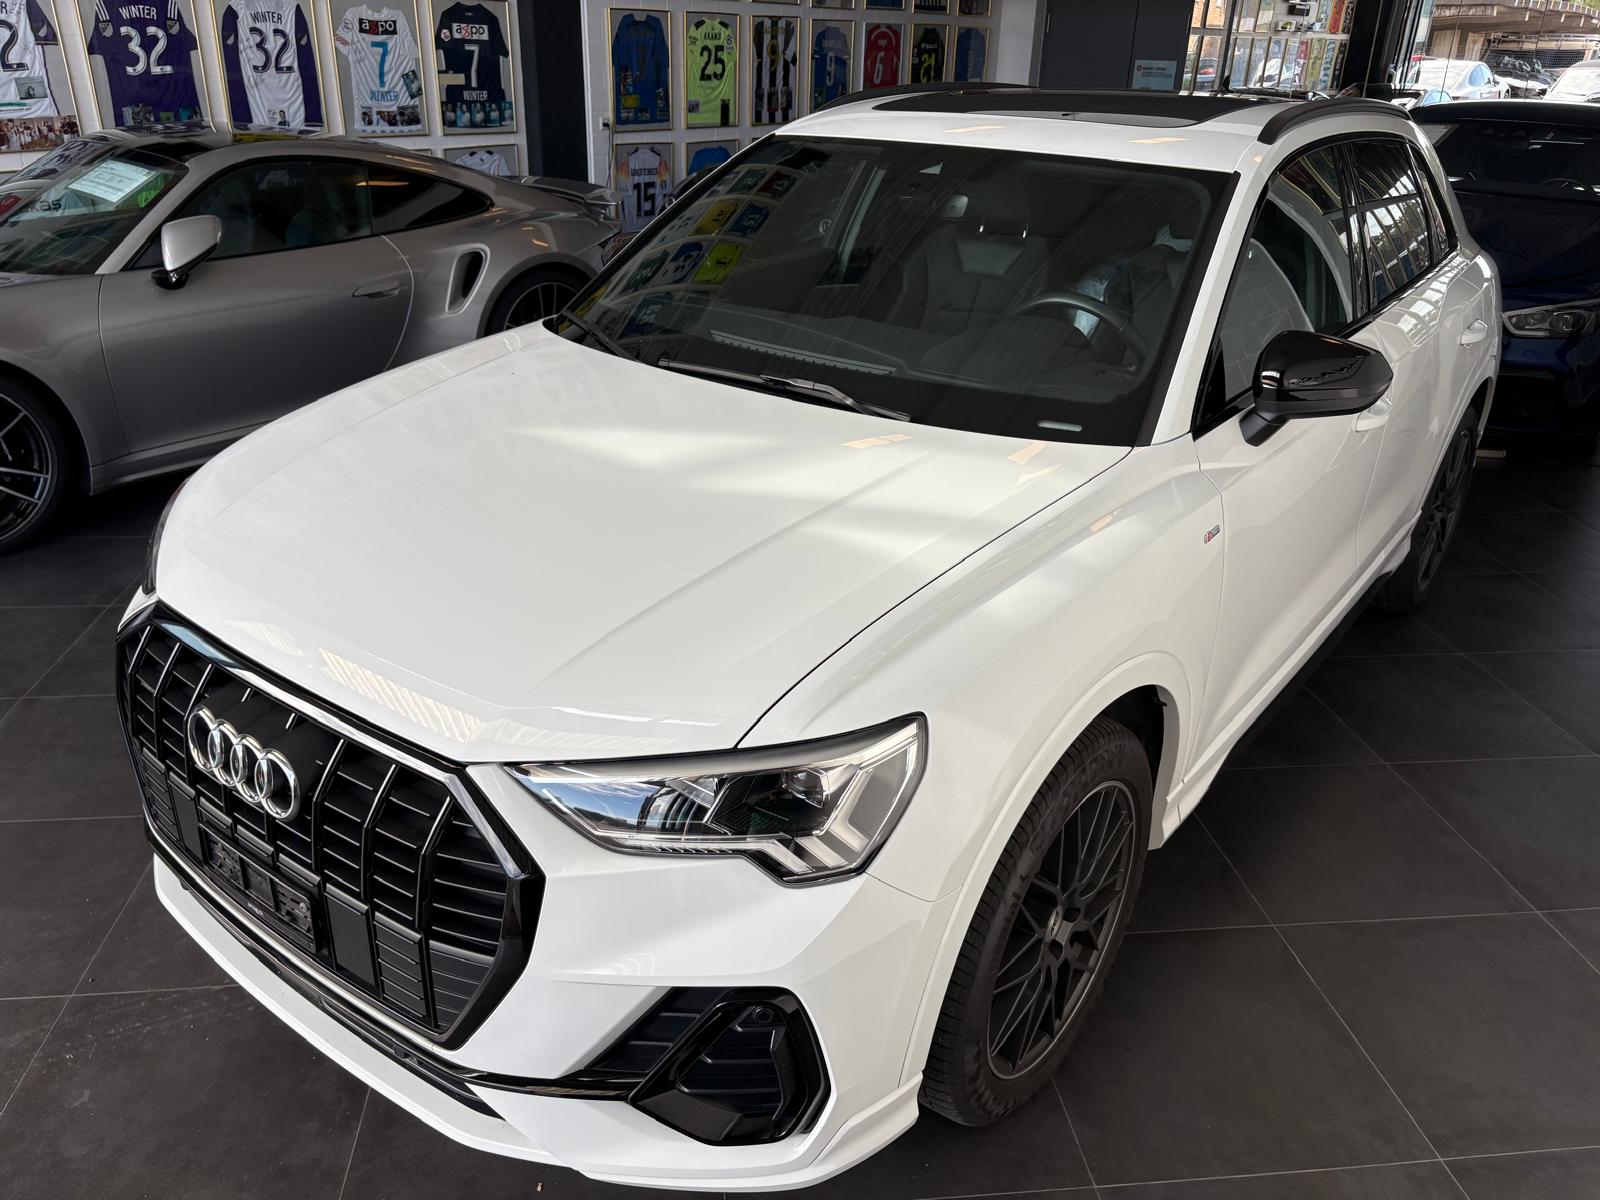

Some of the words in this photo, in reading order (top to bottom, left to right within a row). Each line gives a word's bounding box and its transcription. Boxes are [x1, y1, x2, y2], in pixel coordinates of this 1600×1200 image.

[118, 5, 157, 20] WINTER
[250, 11, 283, 25] WINTER
[119, 25, 174, 75] 32
[249, 26, 296, 75] 32
[370, 41, 388, 88] 7
[464, 43, 480, 88] 7
[700, 45, 726, 81] 25
[826, 52, 836, 86] 9
[873, 51, 885, 85] 6
[920, 53, 936, 84] 21
[370, 89, 399, 102] WINTER
[463, 90, 488, 101] WINTER
[633, 182, 657, 217] 15
